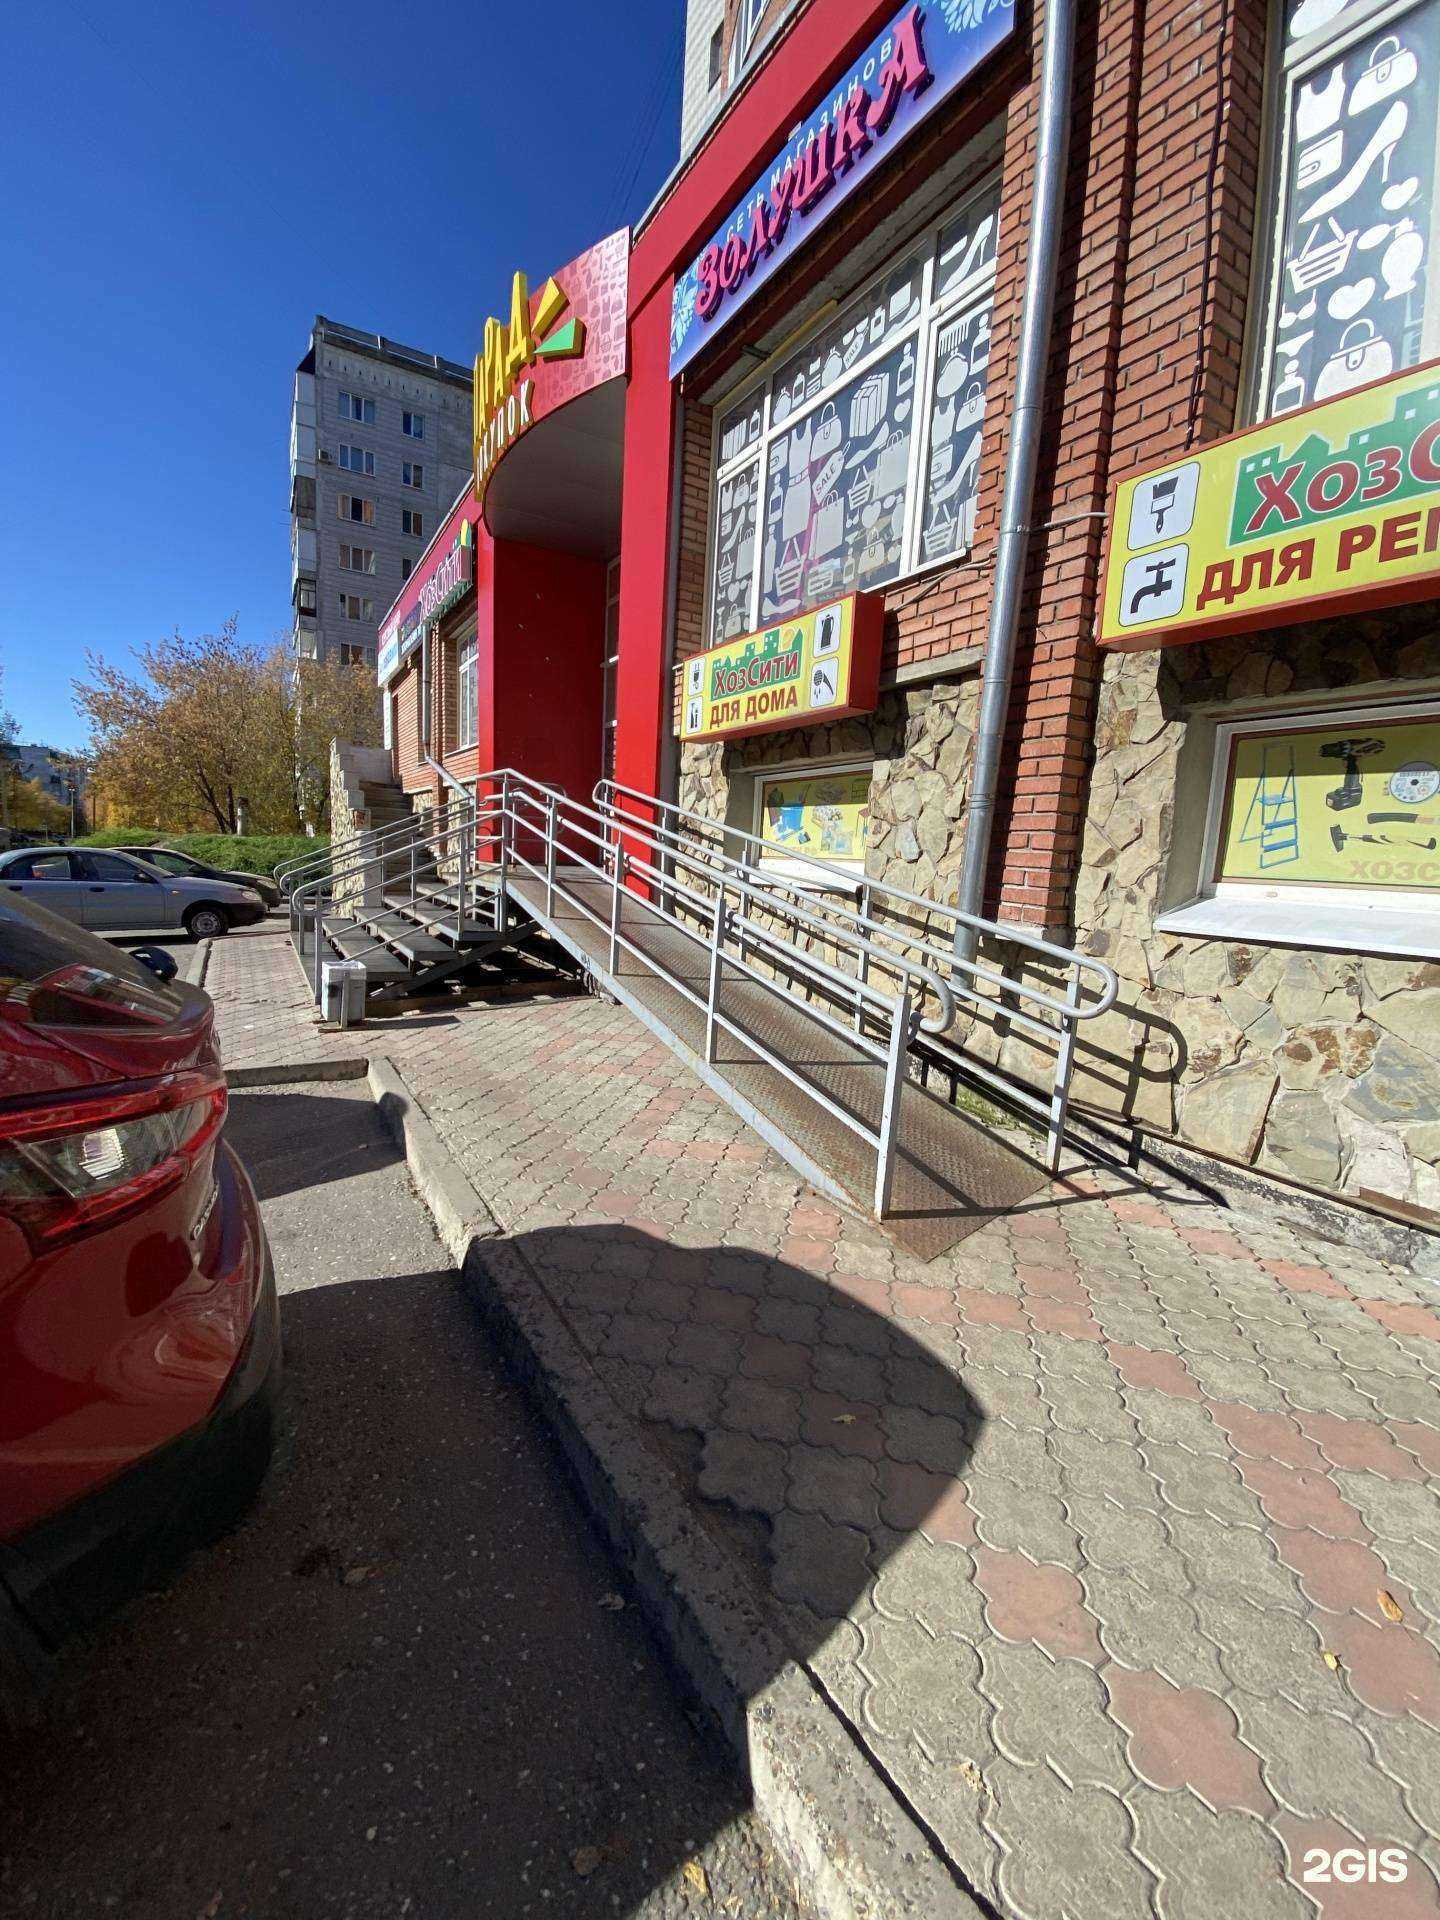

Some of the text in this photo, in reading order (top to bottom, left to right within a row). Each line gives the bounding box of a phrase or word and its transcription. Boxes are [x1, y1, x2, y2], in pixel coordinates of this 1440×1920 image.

[695, 5, 932, 318] ЗОЛУШКА
[726, 41, 893, 240] СЕТЬ МАГАЗИНОВ
[473, 271, 534, 440] ПАРАД
[815, 463, 836, 496] SALE
[1196, 539, 1316, 611] ДЛЯ
[709, 686, 795, 730] ДЛЯ ДОМА
[713, 652, 799, 697] ХозСити
